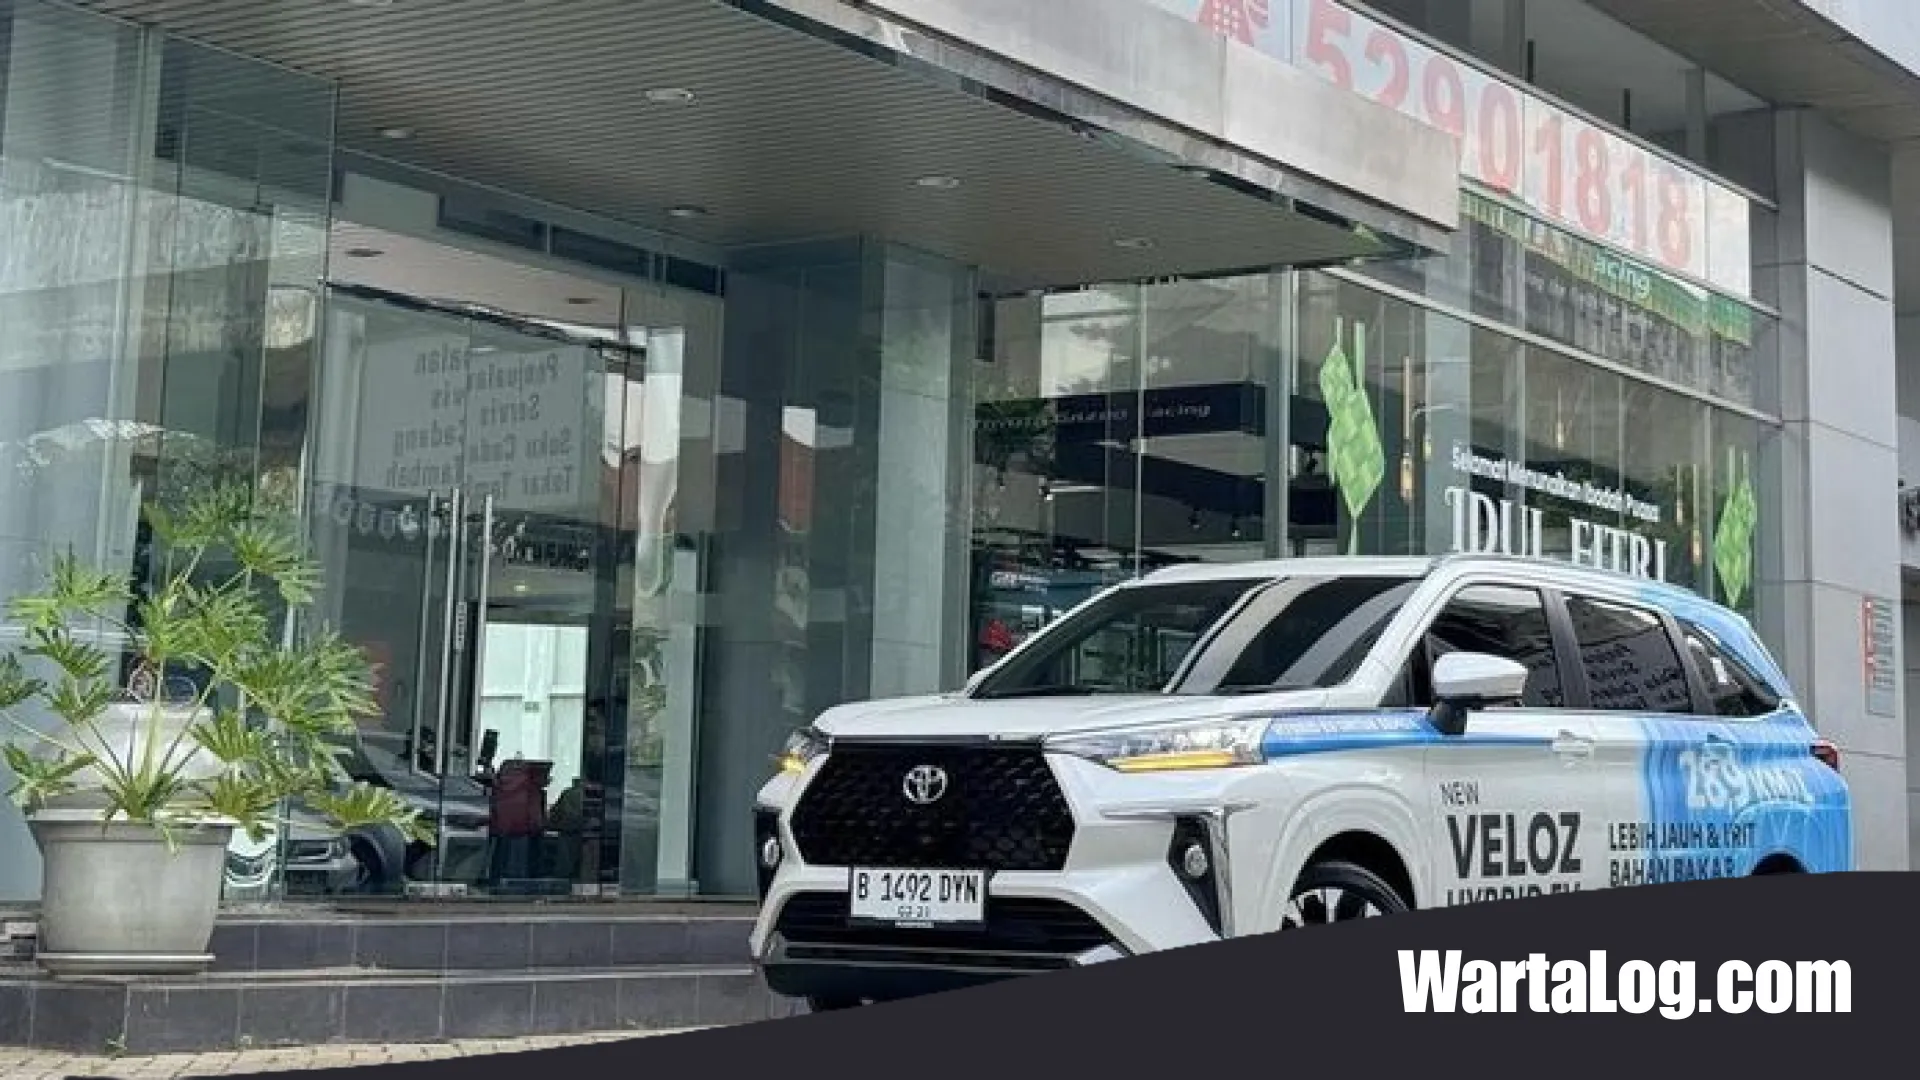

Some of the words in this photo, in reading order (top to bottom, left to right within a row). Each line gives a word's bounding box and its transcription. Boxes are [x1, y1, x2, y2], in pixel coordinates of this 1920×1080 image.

[1444, 486, 1543, 559] IDUL
[1569, 517, 1668, 582] FITRI
[1439, 781, 1479, 806] NEW
[1447, 812, 1581, 879] VELOZ
[1608, 822, 1656, 851] LEBIH
[1659, 822, 1703, 849] JAUH
[1706, 822, 1719, 849] &
[858, 872, 870, 900] B
[880, 872, 932, 902] 1492
[938, 874, 979, 903] DYN
[1609, 858, 1669, 888] BAHAN
